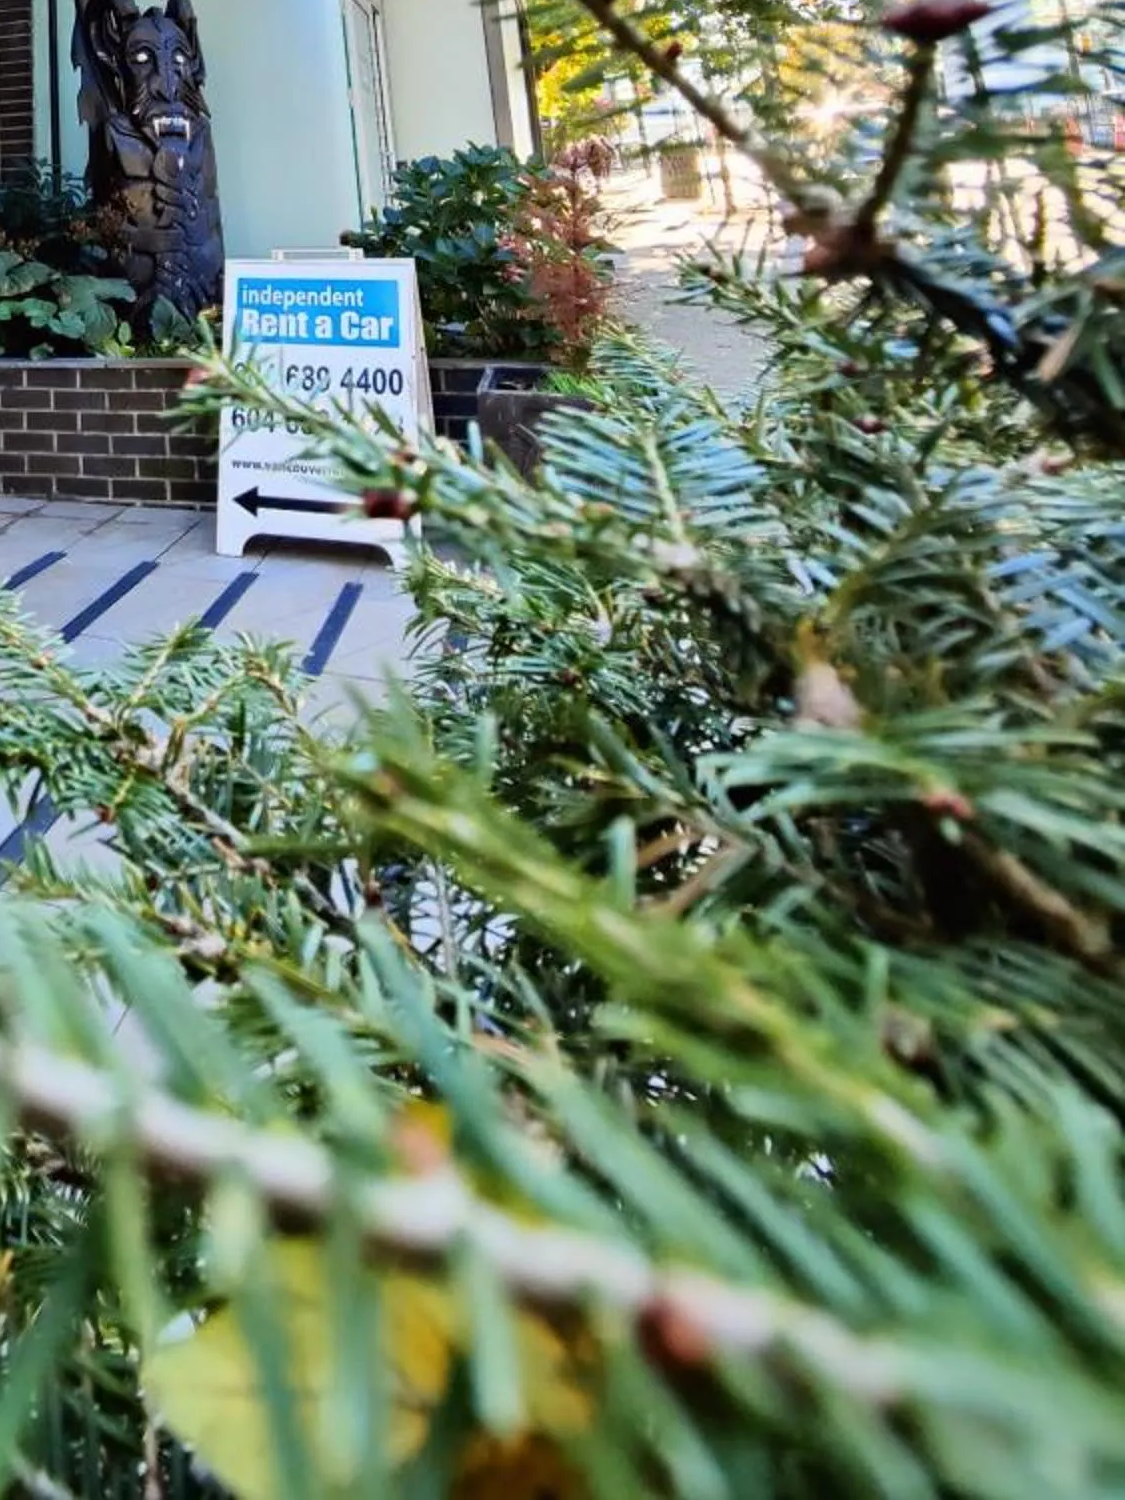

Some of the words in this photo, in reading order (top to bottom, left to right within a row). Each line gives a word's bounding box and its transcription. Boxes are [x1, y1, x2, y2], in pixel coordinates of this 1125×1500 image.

[242, 284, 364, 311] independent
[242, 308, 309, 339] Rent
[314, 315, 333, 339] a
[340, 311, 395, 341] Car
[340, 366, 404, 395] 4400
